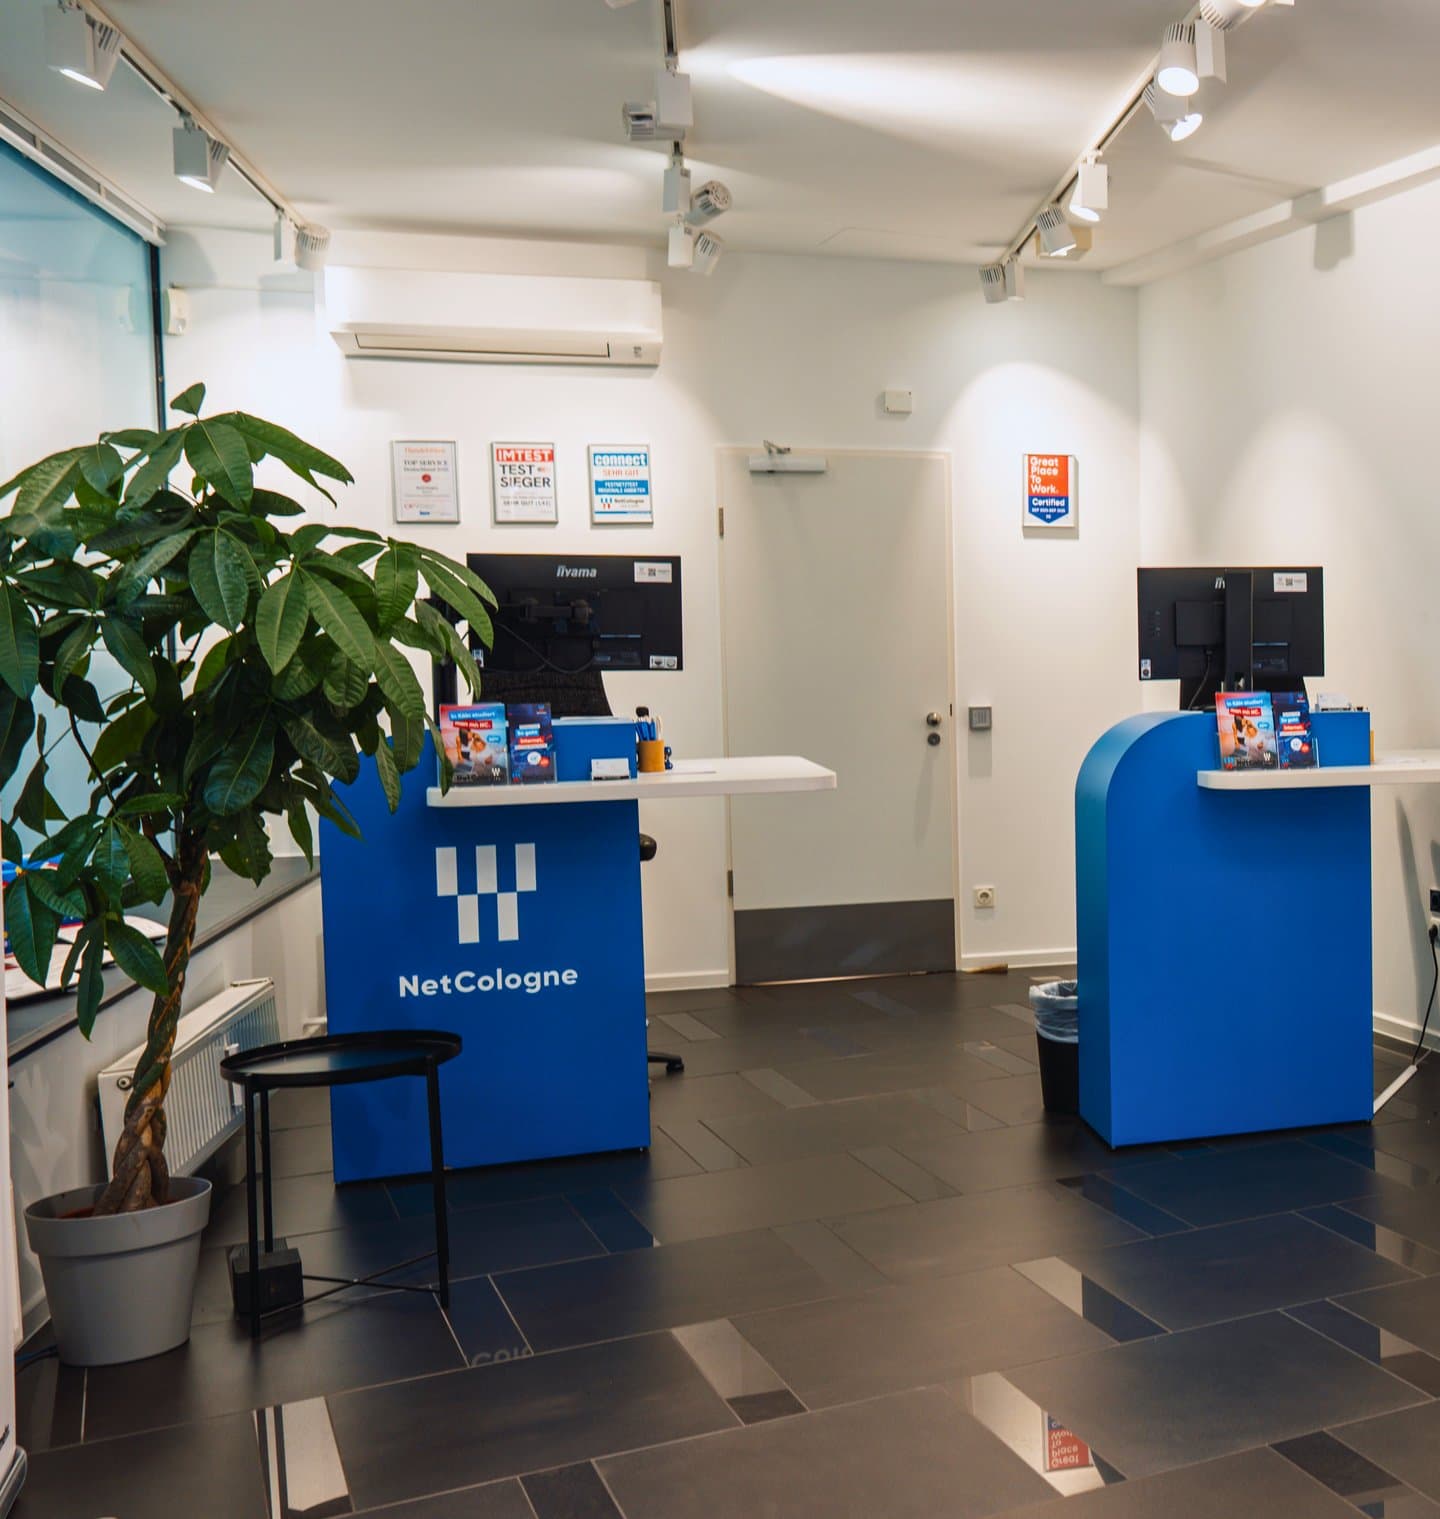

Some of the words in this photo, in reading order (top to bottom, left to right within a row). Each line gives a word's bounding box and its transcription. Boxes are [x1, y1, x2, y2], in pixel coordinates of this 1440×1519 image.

[498, 449, 551, 462] IMTEST
[594, 454, 646, 466] connect
[1030, 456, 1059, 466] Great
[499, 463, 535, 475] TEST
[625, 469, 639, 477] GUT
[1030, 466, 1059, 476] Place
[500, 477, 551, 488] SIEGER
[1030, 475, 1042, 484] To
[1032, 498, 1065, 506] Certified
[556, 565, 598, 578] iiyama
[399, 967, 579, 998] NetCologne
